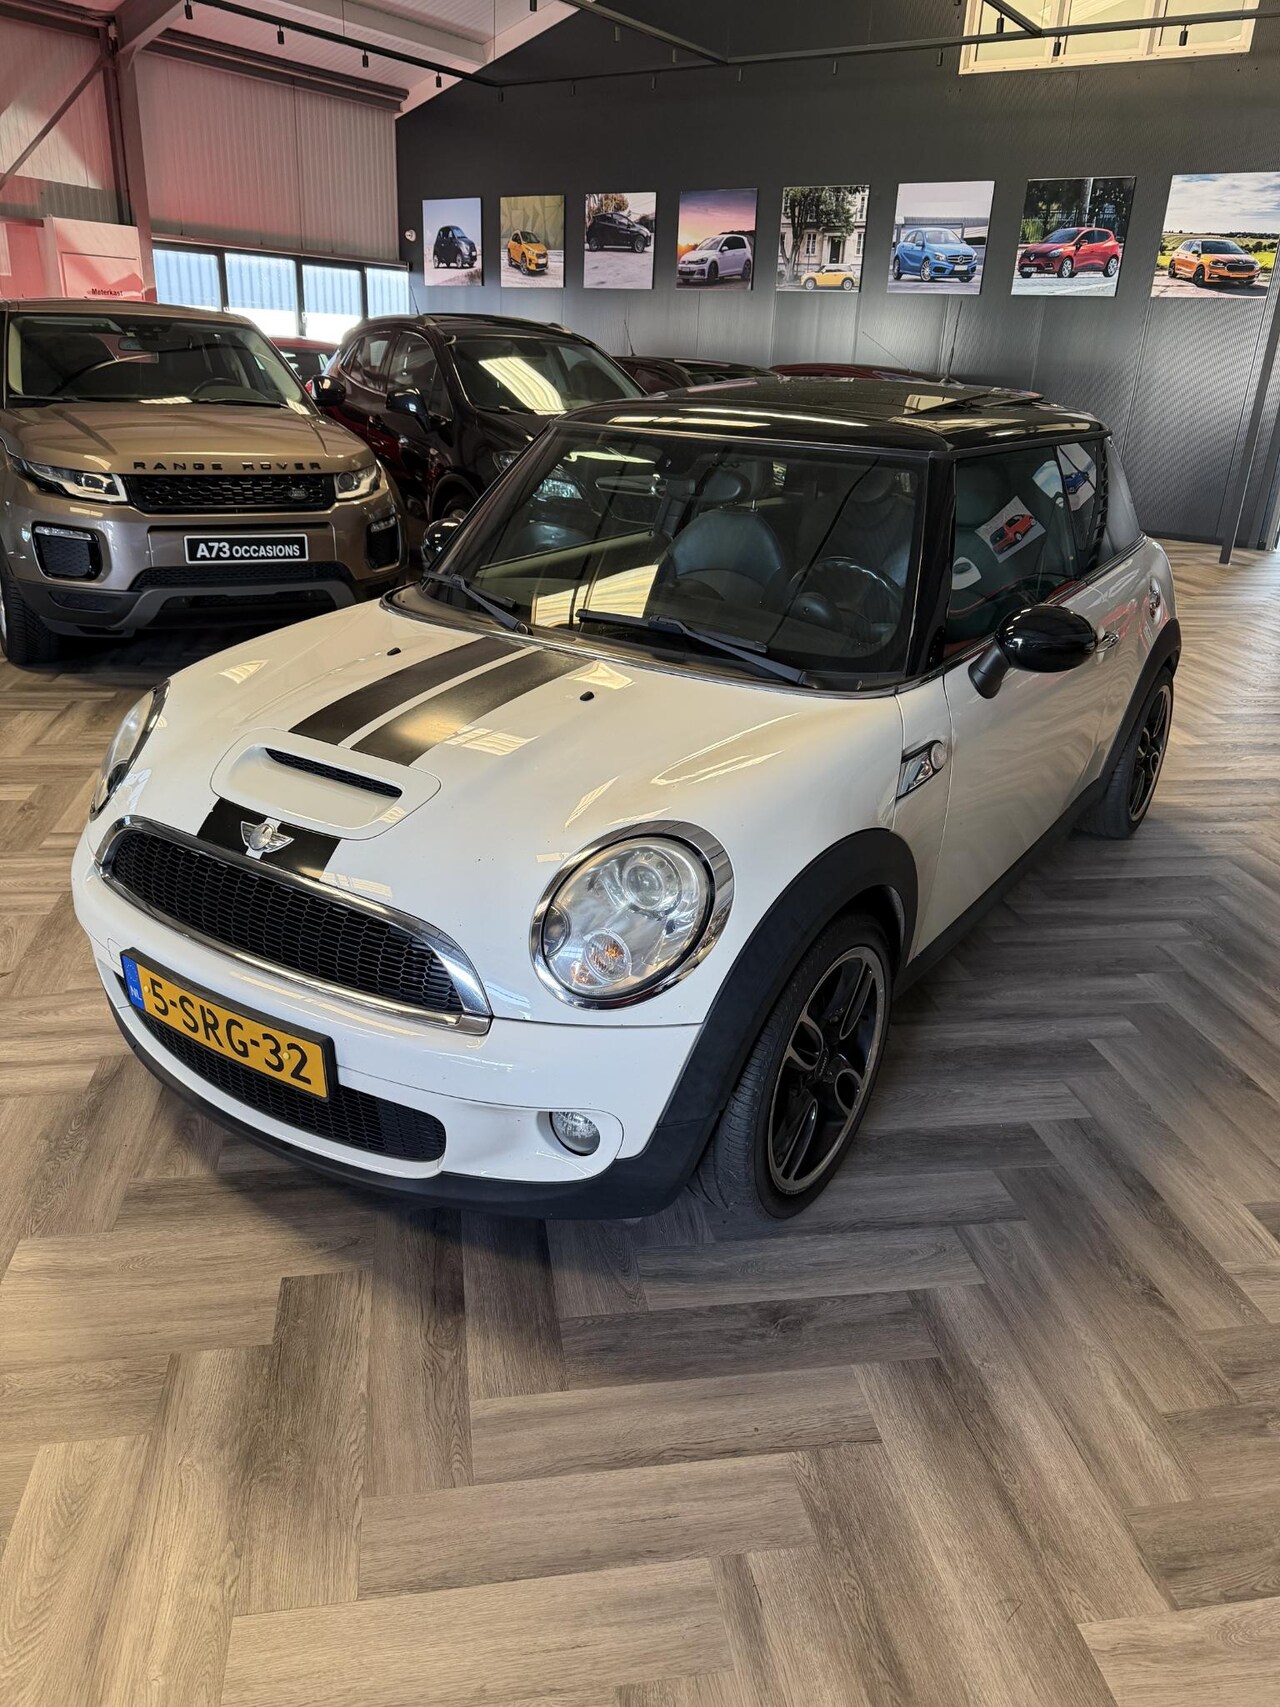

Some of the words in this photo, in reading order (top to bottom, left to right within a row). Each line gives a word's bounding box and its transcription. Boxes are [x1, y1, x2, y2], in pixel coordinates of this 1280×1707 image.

[91, 288, 123, 297] Meterkast
[133, 461, 224, 471] RANGE
[241, 461, 322, 471] ROVER
[196, 541, 231, 559] A73
[232, 544, 300, 558] OCCASIONS
[129, 984, 143, 1001] NL
[149, 976, 312, 1086] 5-SRG-32
